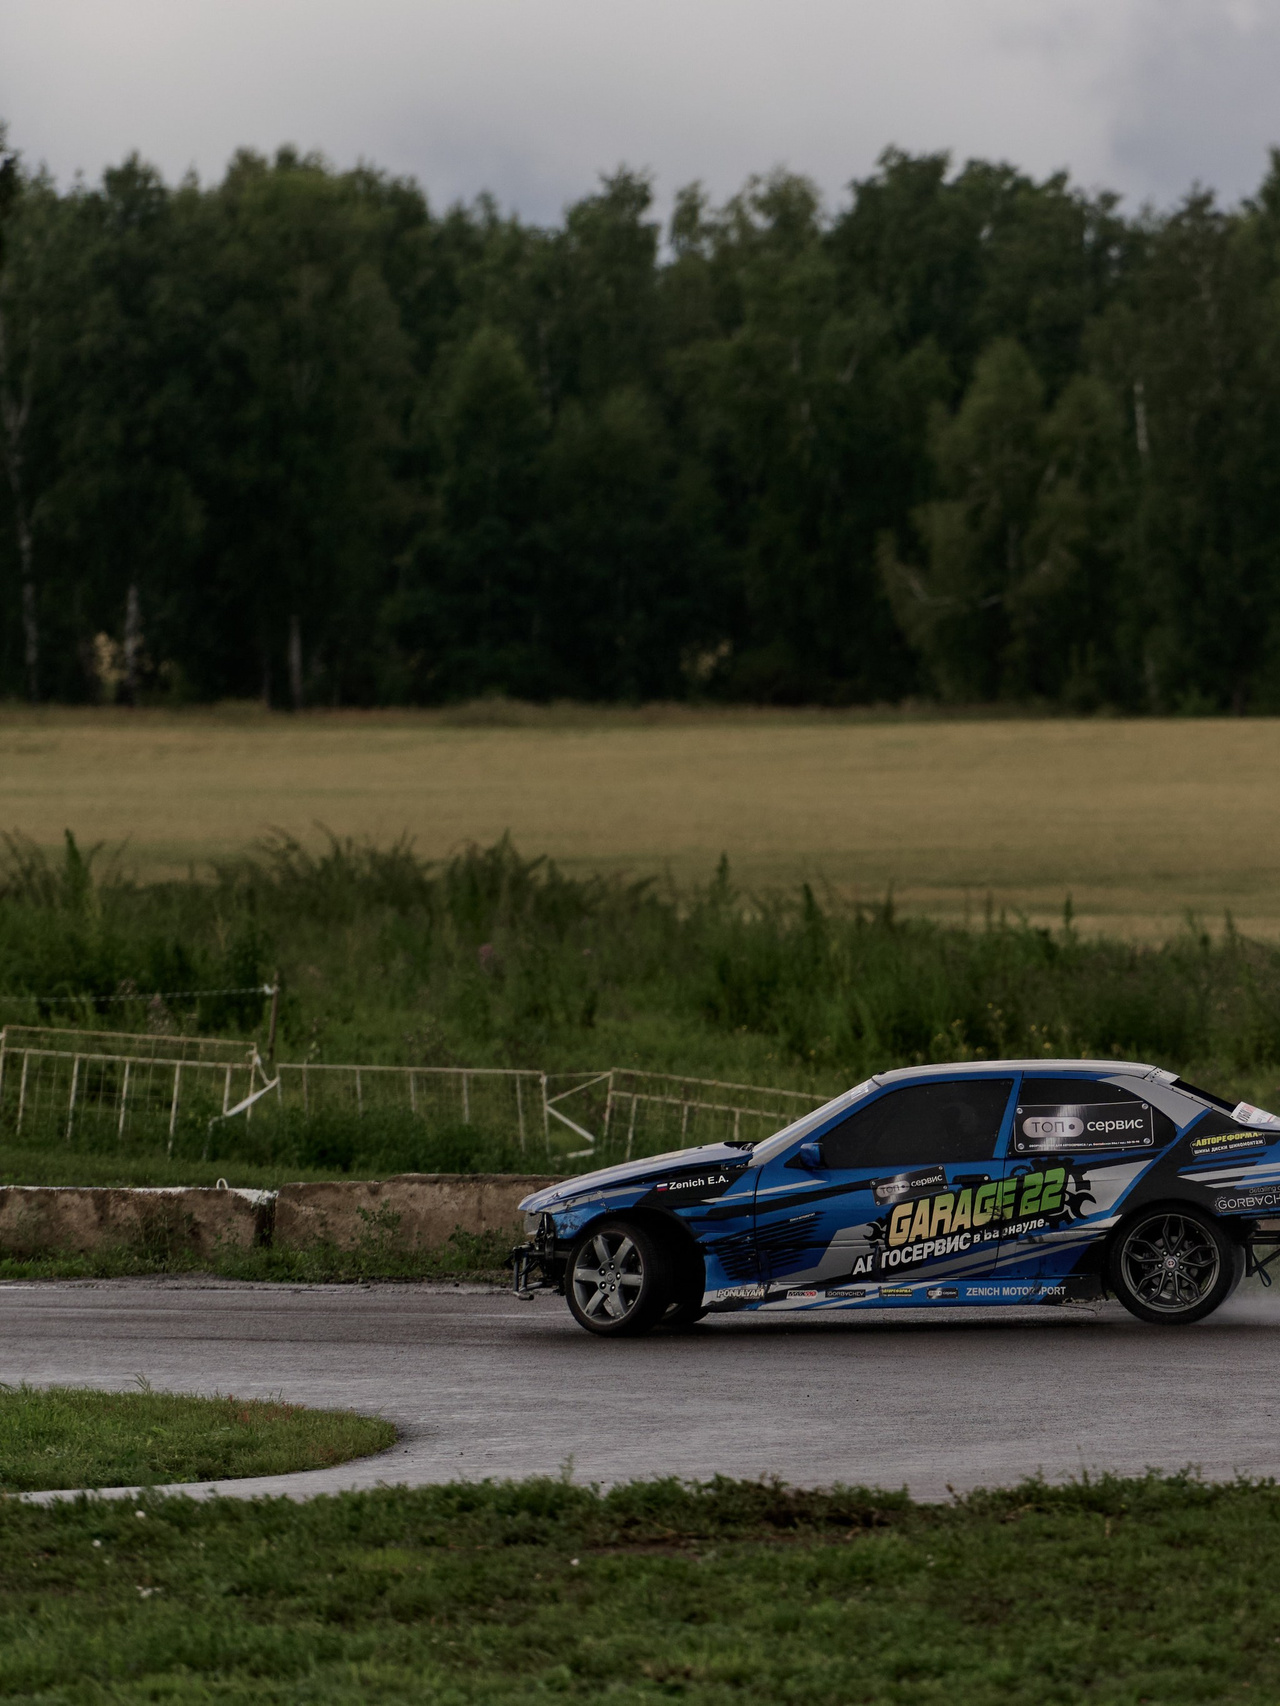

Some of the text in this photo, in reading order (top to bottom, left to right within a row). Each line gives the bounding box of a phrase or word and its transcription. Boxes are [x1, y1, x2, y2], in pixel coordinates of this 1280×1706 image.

[1031, 1118, 1144, 1134] ТОП сервис
[669, 1174, 730, 1190] Zenich E.A.
[911, 1174, 943, 1187] сервис
[1248, 1185, 1277, 1194] detailing
[888, 1167, 1066, 1247] GARAGE 22
[966, 1286, 1066, 1296] ZENICH MOTORPORT
